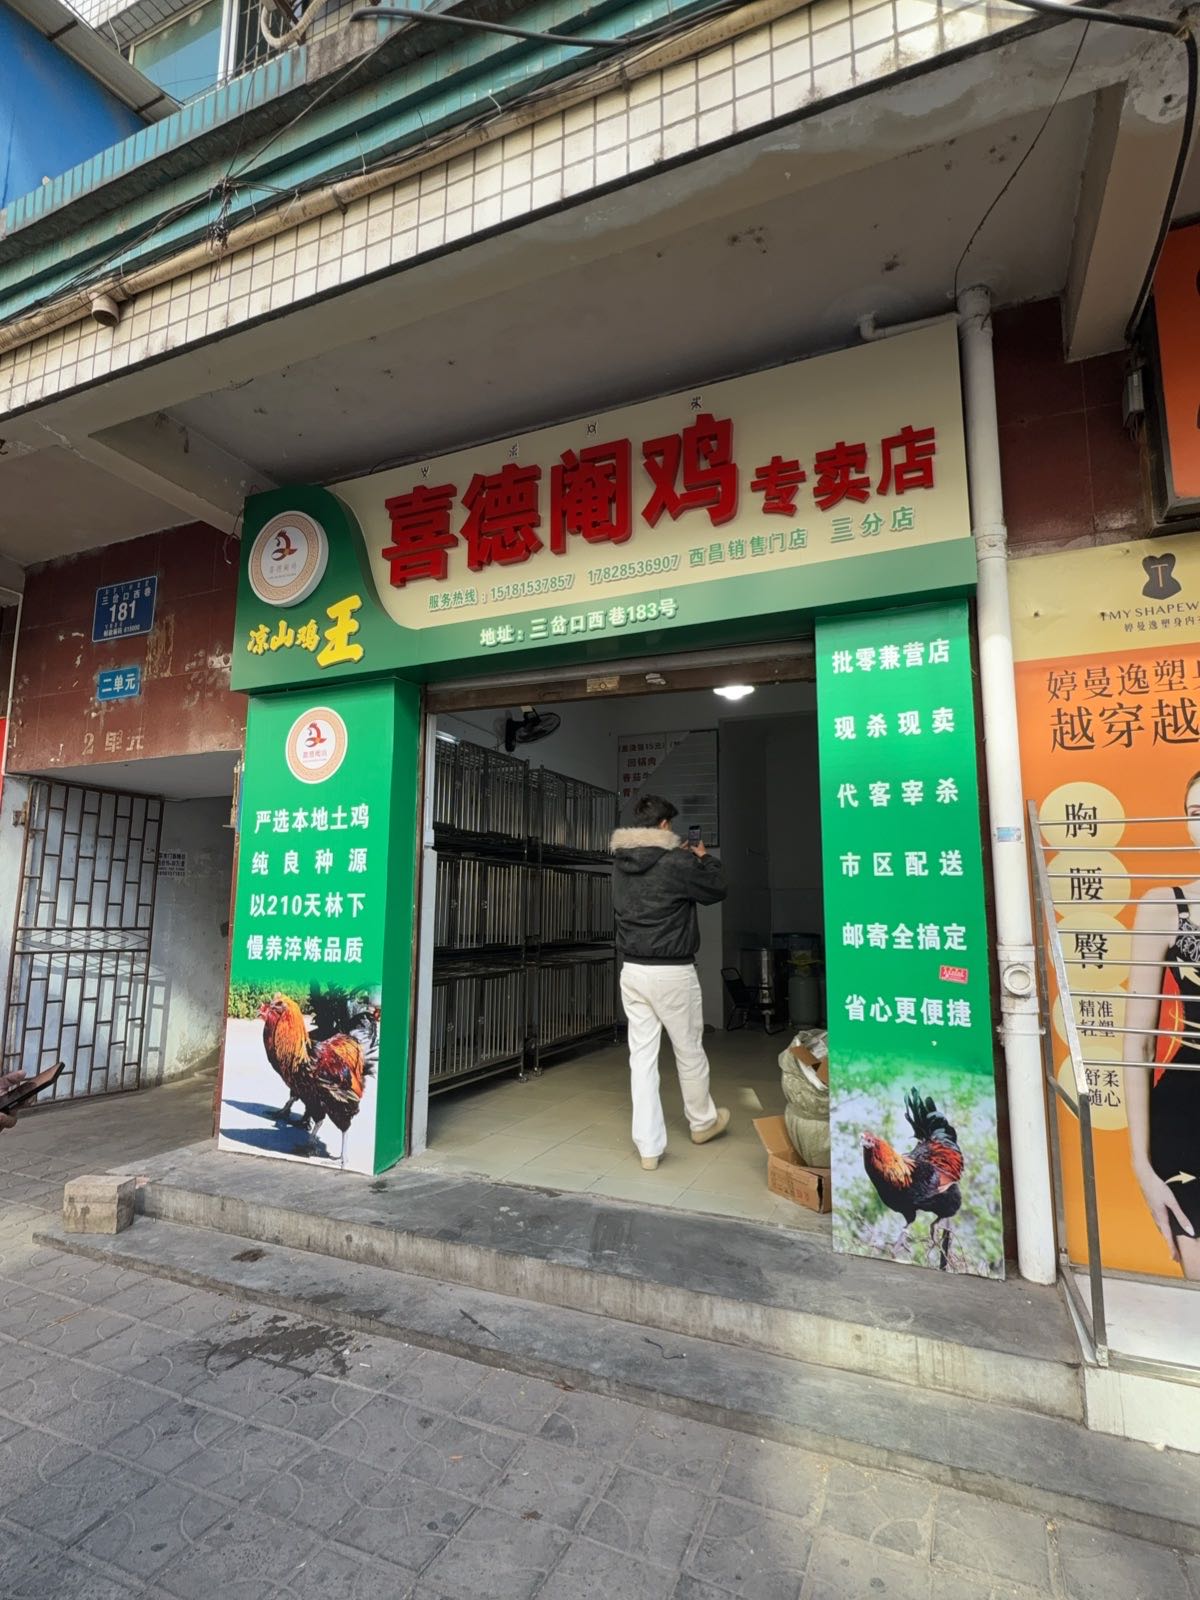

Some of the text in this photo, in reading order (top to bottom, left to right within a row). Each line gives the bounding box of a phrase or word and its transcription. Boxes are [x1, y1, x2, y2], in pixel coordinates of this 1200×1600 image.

[750, 425, 936, 518] 专卖店
[588, 554, 681, 584] 17828536907
[688, 527, 809, 567] 西昌销售门店
[830, 506, 915, 544] 三分店
[109, 599, 136, 623] 181
[1123, 614, 1200, 633] 婷曼逸塑身内
[831, 638, 951, 675] 批零兼营店
[101, 672, 137, 694] 二单元
[834, 706, 956, 742] 现杀现卖
[836, 777, 960, 809] 代客宰杀
[255, 804, 369, 834] 严选本地土鸡
[1064, 803, 1098, 838] 胸
[252, 847, 367, 875] 纯良种源
[840, 851, 964, 878] 市区配送
[1069, 867, 1104, 901] 腰
[250, 892, 365, 918] 以210天林下
[247, 934, 363, 963] 慢养淬炼品质
[841, 922, 969, 952] 邮寄全搞定
[843, 993, 973, 1029] 省心更便捷
[1079, 999, 1114, 1018] 精准
[1084, 1067, 1120, 1088] 舒柔
[1087, 1088, 1122, 1108] 随心
